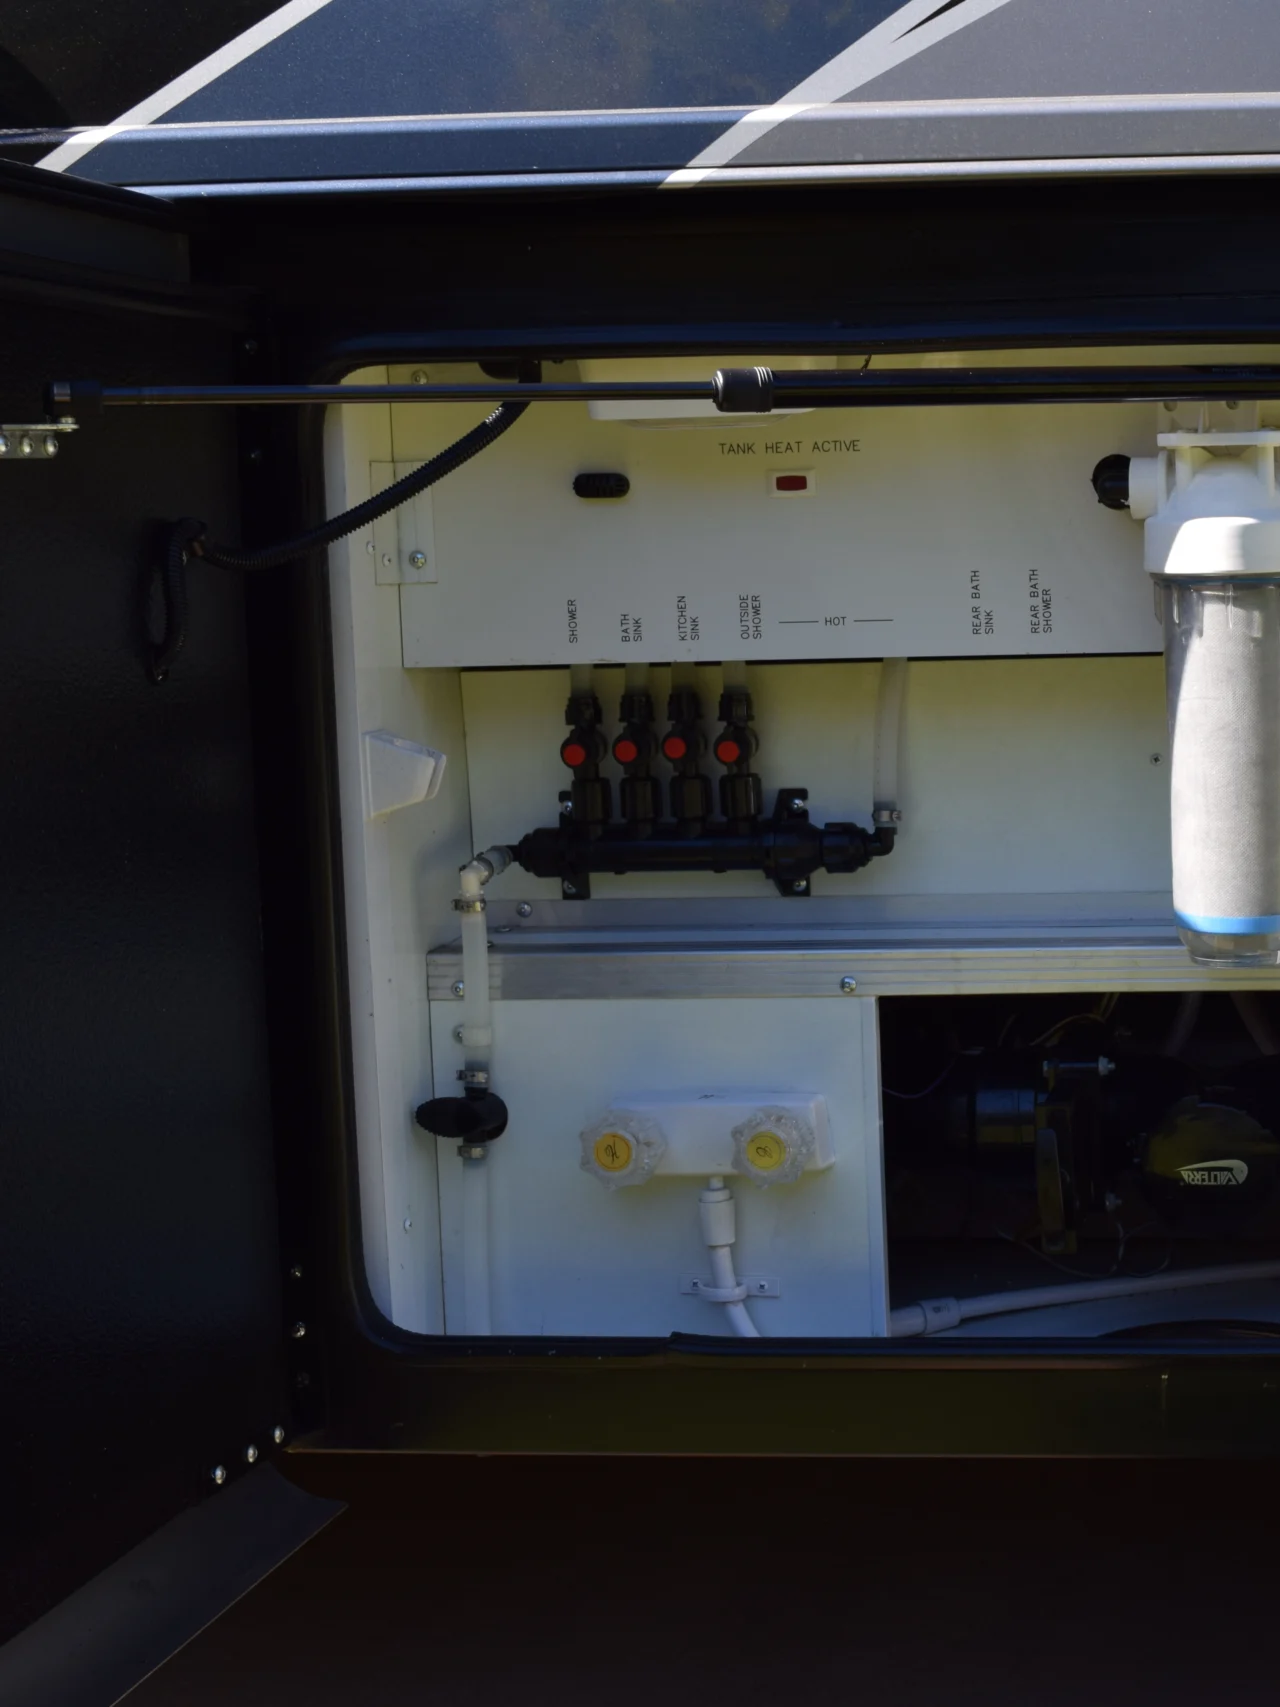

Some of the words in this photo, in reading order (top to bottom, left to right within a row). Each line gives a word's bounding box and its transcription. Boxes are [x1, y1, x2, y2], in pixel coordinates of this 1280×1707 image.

[718, 442, 756, 454] TANK
[766, 441, 802, 454] HEAT
[812, 440, 861, 452] ACTIVE
[970, 570, 980, 599] BATH
[1029, 569, 1040, 598] BATH
[568, 599, 578, 644] SHOWER
[677, 595, 688, 642] KITCHEN
[739, 594, 750, 640] OUTSIDE
[752, 594, 762, 640] SHOWER
[824, 616, 847, 626] HOT
[972, 606, 982, 635] REAR
[984, 610, 994, 634] SINK
[1030, 604, 1040, 634] REAR
[1042, 588, 1052, 634] SHOWER
[620, 614, 630, 642] BATH
[633, 617, 642, 642] SINK
[690, 616, 700, 640] SINK
[1180, 1170, 1238, 1186] VALTERRA
